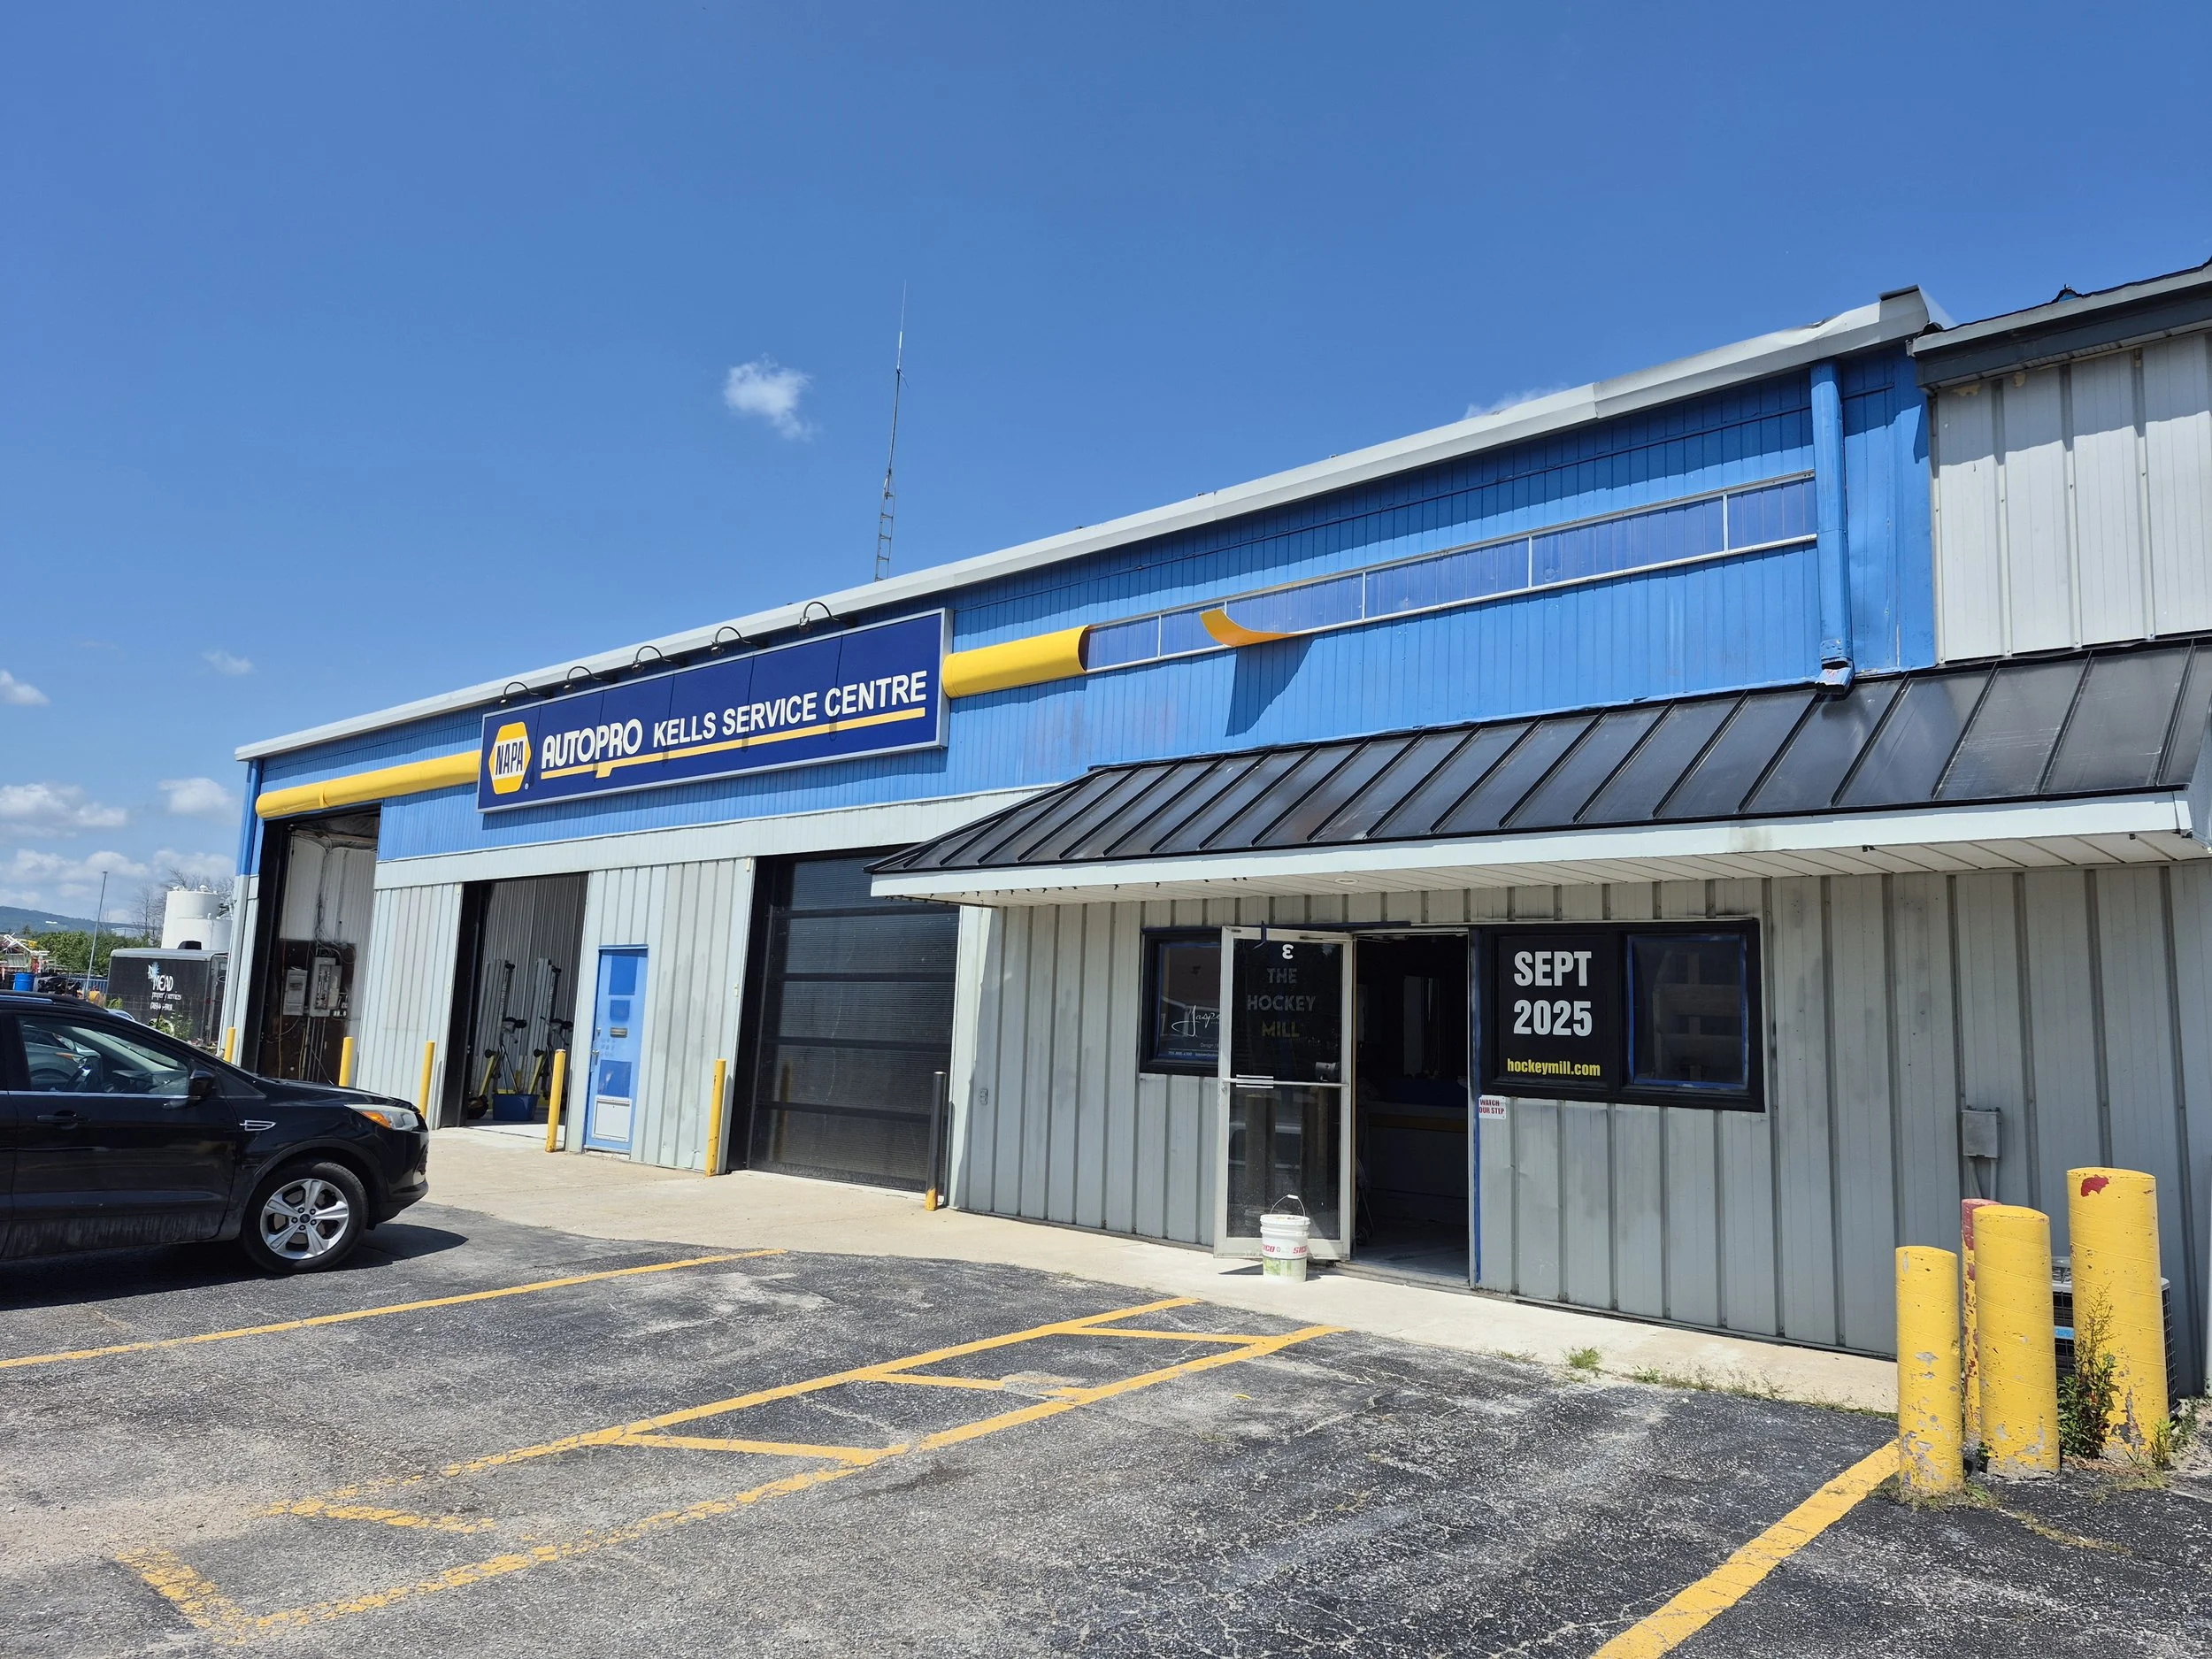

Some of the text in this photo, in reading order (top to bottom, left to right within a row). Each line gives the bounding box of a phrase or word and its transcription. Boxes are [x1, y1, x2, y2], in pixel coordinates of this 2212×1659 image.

[541, 670, 927, 769] AUTOPRO KELLS SERVICE CENTRE
[495, 741, 524, 775] NAPA
[1267, 968, 1298, 984] THE
[1514, 951, 1592, 987] SEPT
[152, 975, 173, 991] MEAD
[1247, 995, 1317, 1011] HOCKEY
[1514, 999, 1593, 1037] 2025
[1262, 1020, 1301, 1037] MILL
[1508, 1058, 1601, 1077] hockeymill.com
